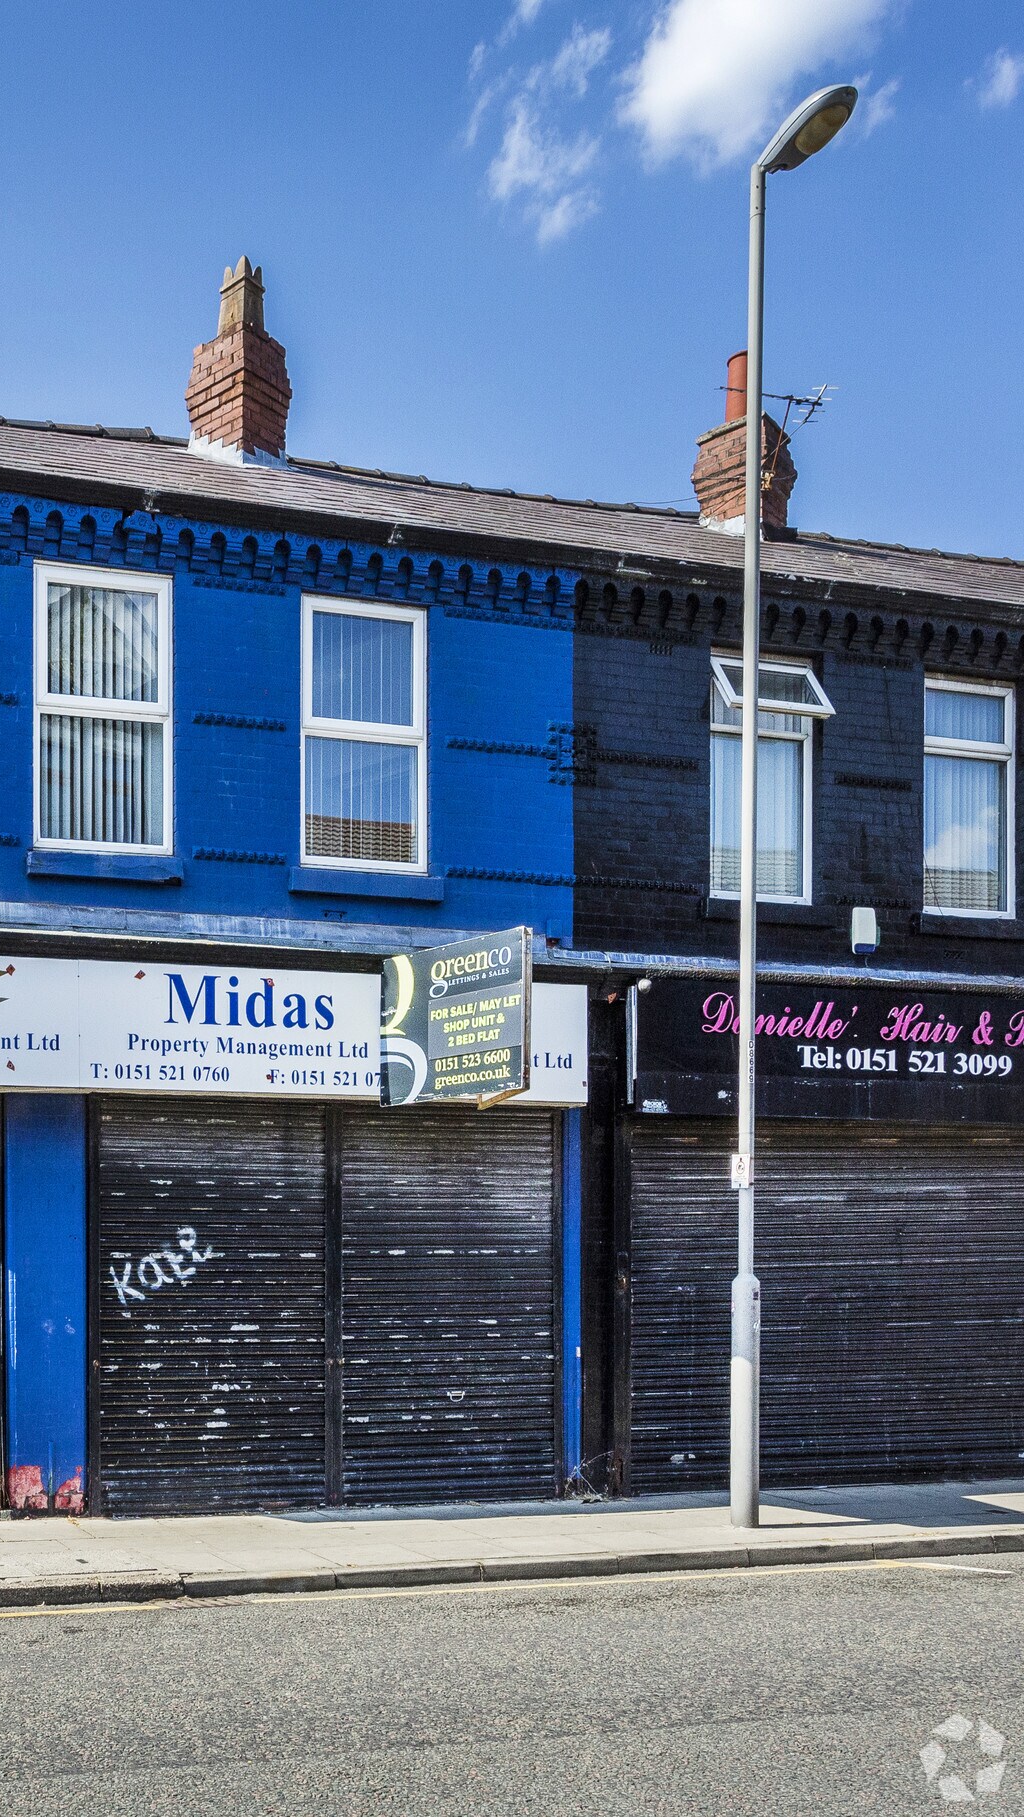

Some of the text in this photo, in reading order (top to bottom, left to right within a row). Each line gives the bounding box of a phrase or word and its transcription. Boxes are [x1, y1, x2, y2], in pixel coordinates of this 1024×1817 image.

[429, 946, 512, 998] greenco
[448, 975, 480, 986] LETTINGS
[489, 968, 510, 978] SALES
[163, 972, 335, 1030] Midas
[430, 1008, 448, 1021] FOR
[479, 999, 501, 1011] MAY
[503, 994, 521, 1006] LET
[443, 1013, 505, 1034] SHOP UNIT &
[880, 1003, 963, 1041] Hair
[972, 1010, 994, 1045] &
[26, 1033, 60, 1051] Ltd
[127, 1033, 369, 1060] Property Management Ltd
[448, 1029, 500, 1047] 2 BED FLAT
[435, 1048, 511, 1072] 0151 523 6600
[545, 1052, 572, 1068] Ltd
[797, 1045, 1012, 1077] Tel: 0151 521 3099
[90, 1063, 109, 1079] T:
[114, 1063, 151, 1080] 0151
[157, 1063, 188, 1081] 521
[193, 1064, 230, 1082] 0760
[268, 1068, 287, 1084] F:
[291, 1069, 329, 1086] 0151
[333, 1070, 358, 1087] 521
[435, 1065, 511, 1090] greenco.co.uk
